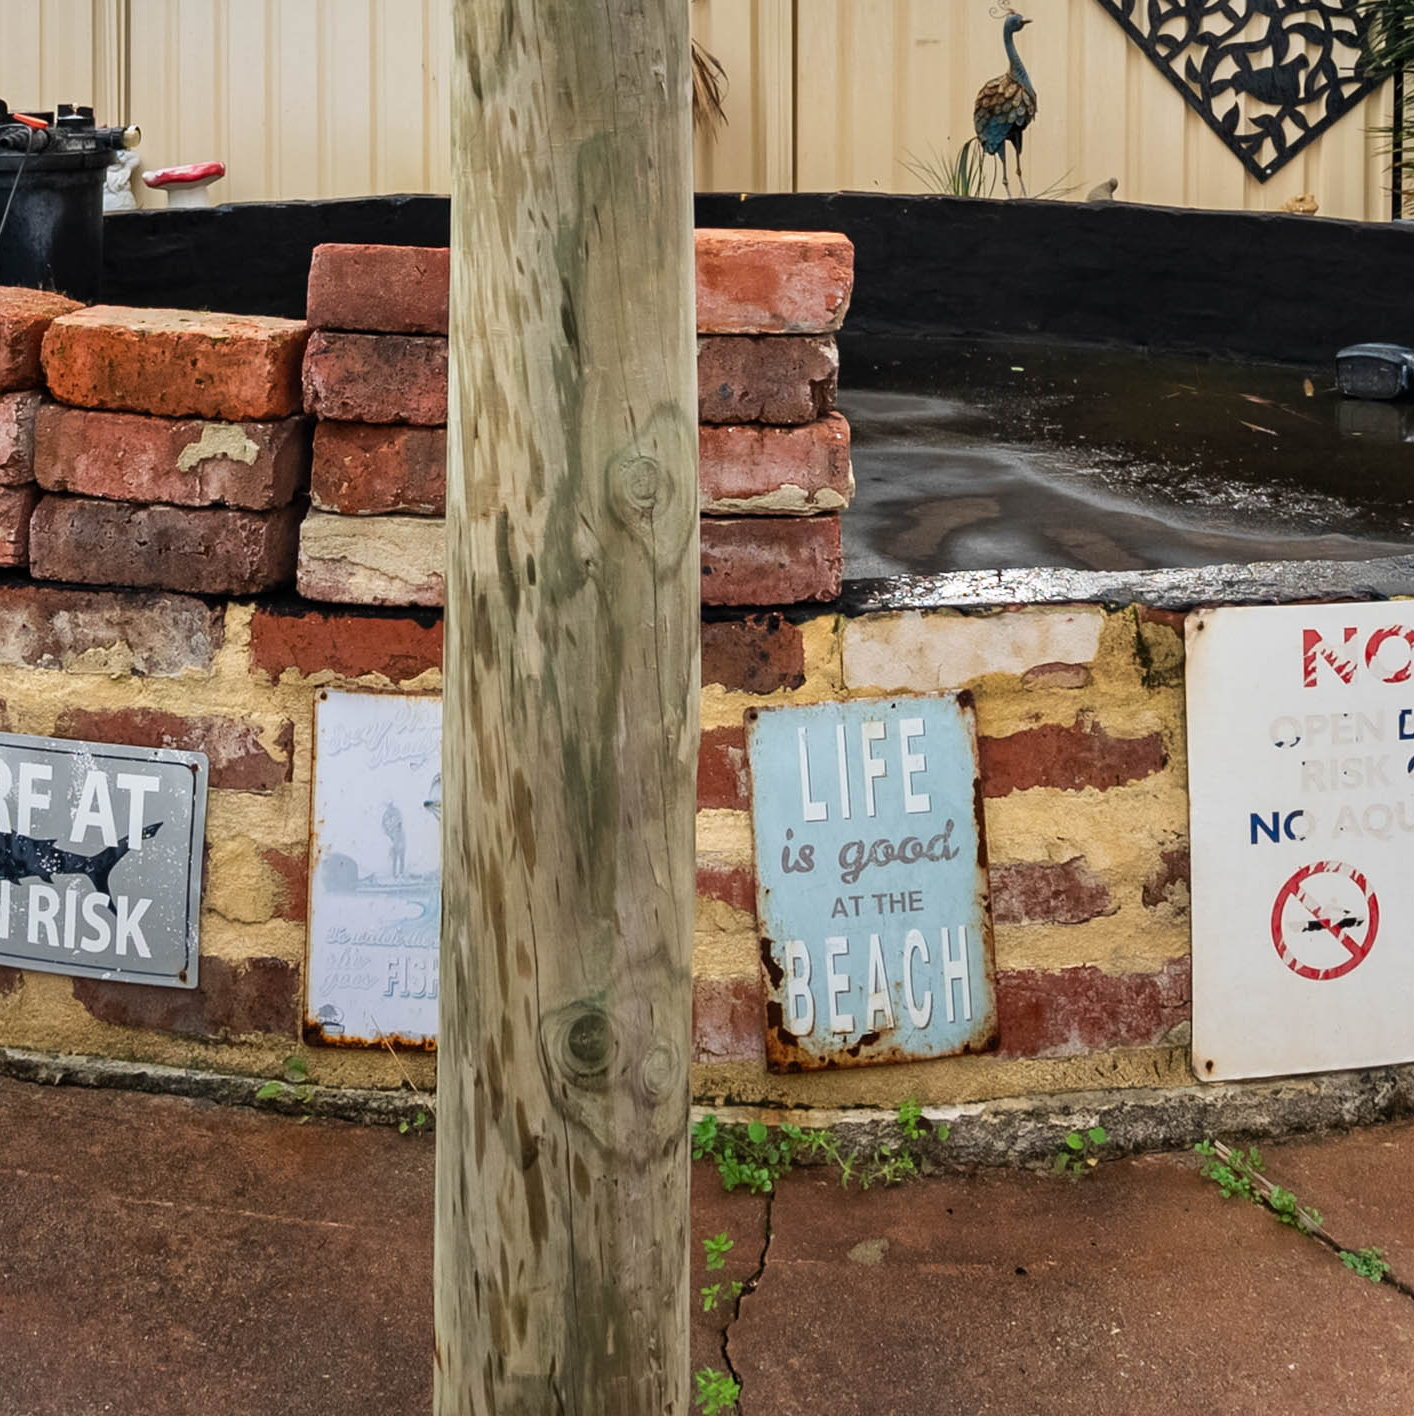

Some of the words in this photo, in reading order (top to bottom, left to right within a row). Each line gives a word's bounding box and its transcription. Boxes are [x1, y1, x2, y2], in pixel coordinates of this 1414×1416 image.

[1269, 711, 1386, 748] OPEN
[797, 717, 932, 822] LIFE
[1301, 755, 1391, 793] RISK
[69, 770, 160, 851] AT
[1250, 810, 1316, 845] NO
[781, 828, 815, 874] is
[838, 818, 960, 885] good
[27, 884, 153, 958] RISK
[831, 895, 865, 919] AT
[872, 890, 925, 915] THE
[786, 925, 972, 1037] BEACH
